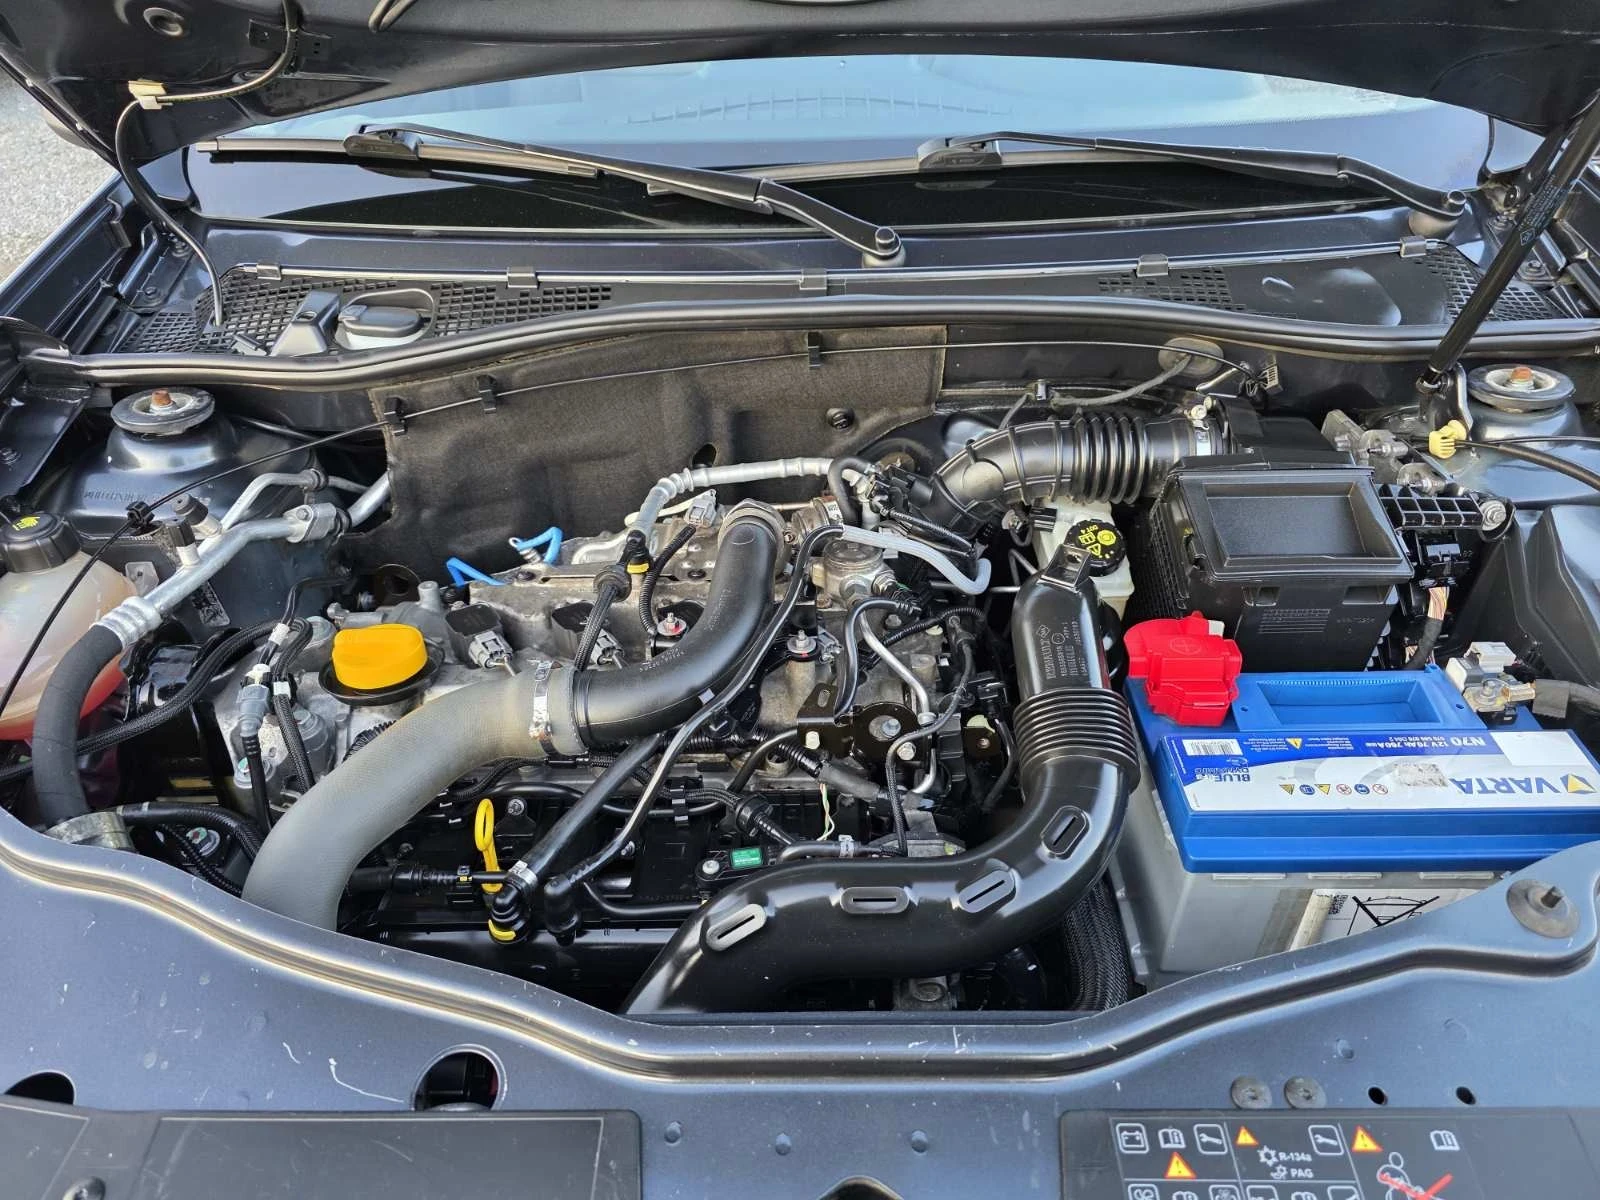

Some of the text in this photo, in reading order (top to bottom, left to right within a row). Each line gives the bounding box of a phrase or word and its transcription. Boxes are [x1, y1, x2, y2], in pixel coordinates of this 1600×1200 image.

[1450, 737, 1487, 747] N70
[1214, 773, 1251, 783] BLUE
[1449, 777, 1561, 794] VARTA
[1290, 1168, 1314, 1178] PAG
